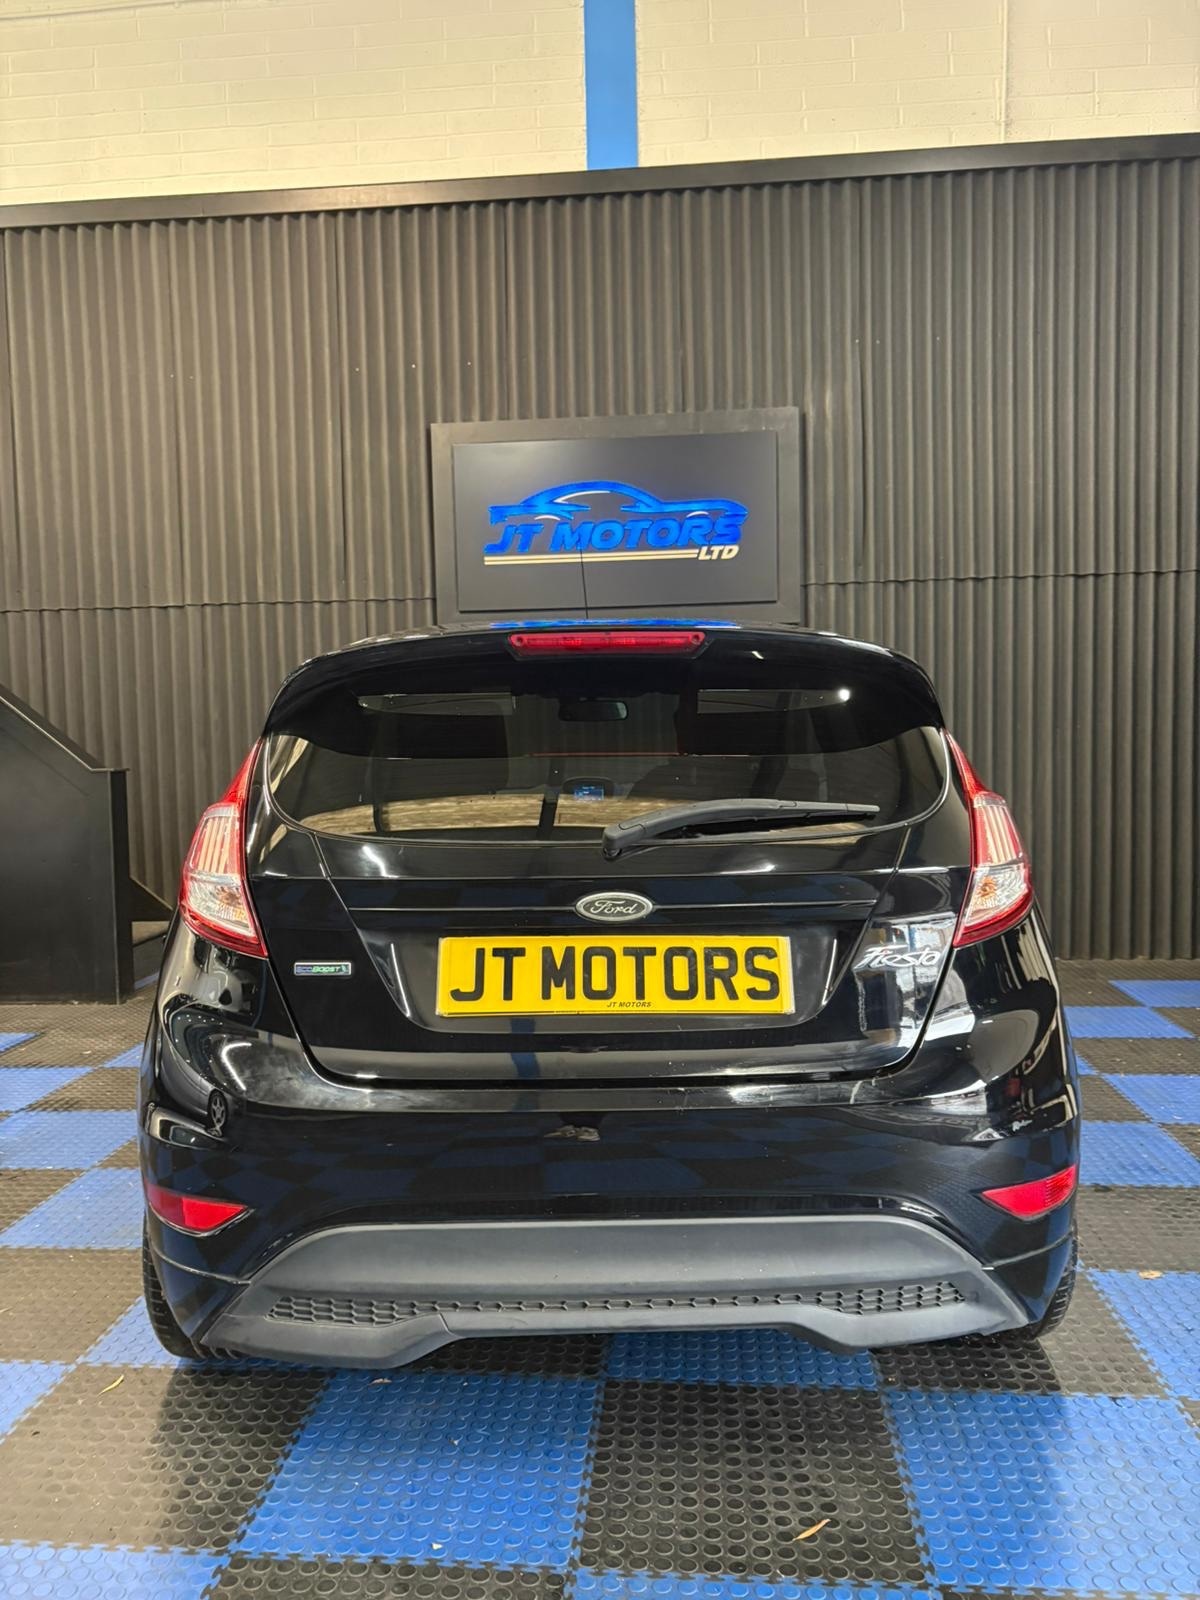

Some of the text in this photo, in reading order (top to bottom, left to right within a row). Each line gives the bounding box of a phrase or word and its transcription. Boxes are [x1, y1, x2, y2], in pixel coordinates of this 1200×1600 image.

[484, 516, 743, 553] JT MOTORS
[698, 545, 739, 560] LTD
[590, 900, 638, 914] Ford
[853, 944, 941, 969] Fiesta
[450, 946, 780, 1001] JT MOTORS
